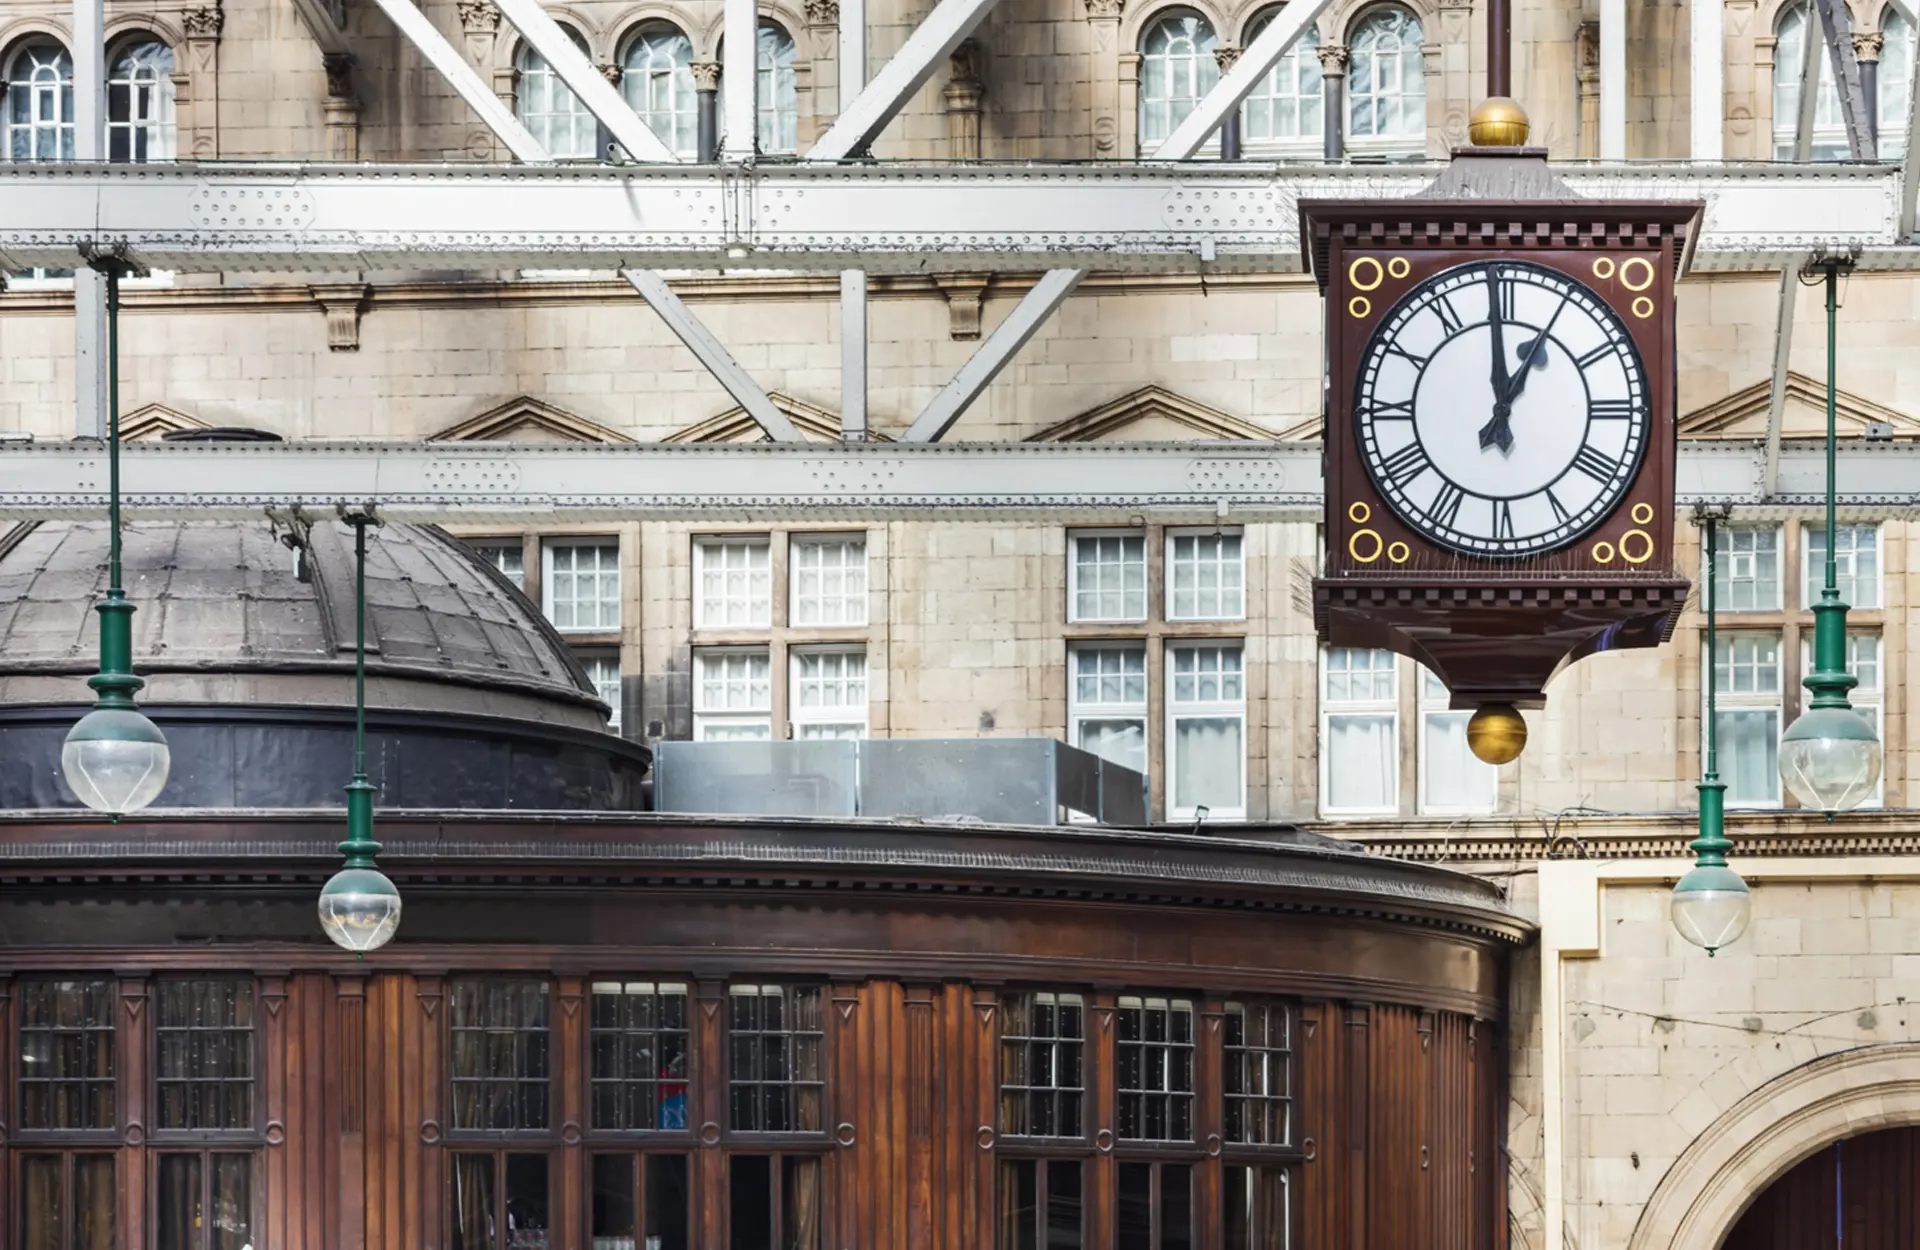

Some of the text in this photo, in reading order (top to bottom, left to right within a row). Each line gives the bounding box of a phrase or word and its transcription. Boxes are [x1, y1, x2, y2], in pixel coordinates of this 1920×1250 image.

[1426, 294, 1464, 338] XI
[1386, 339, 1430, 371] X
[1576, 340, 1617, 370] II
[1372, 399, 1413, 421] IX
[1589, 399, 1631, 420] III
[1382, 440, 1431, 490] VIII
[1571, 443, 1621, 486] IIII
[1426, 480, 1465, 529] VII
[1492, 499, 1515, 540] VI
[1544, 486, 1571, 525] V
